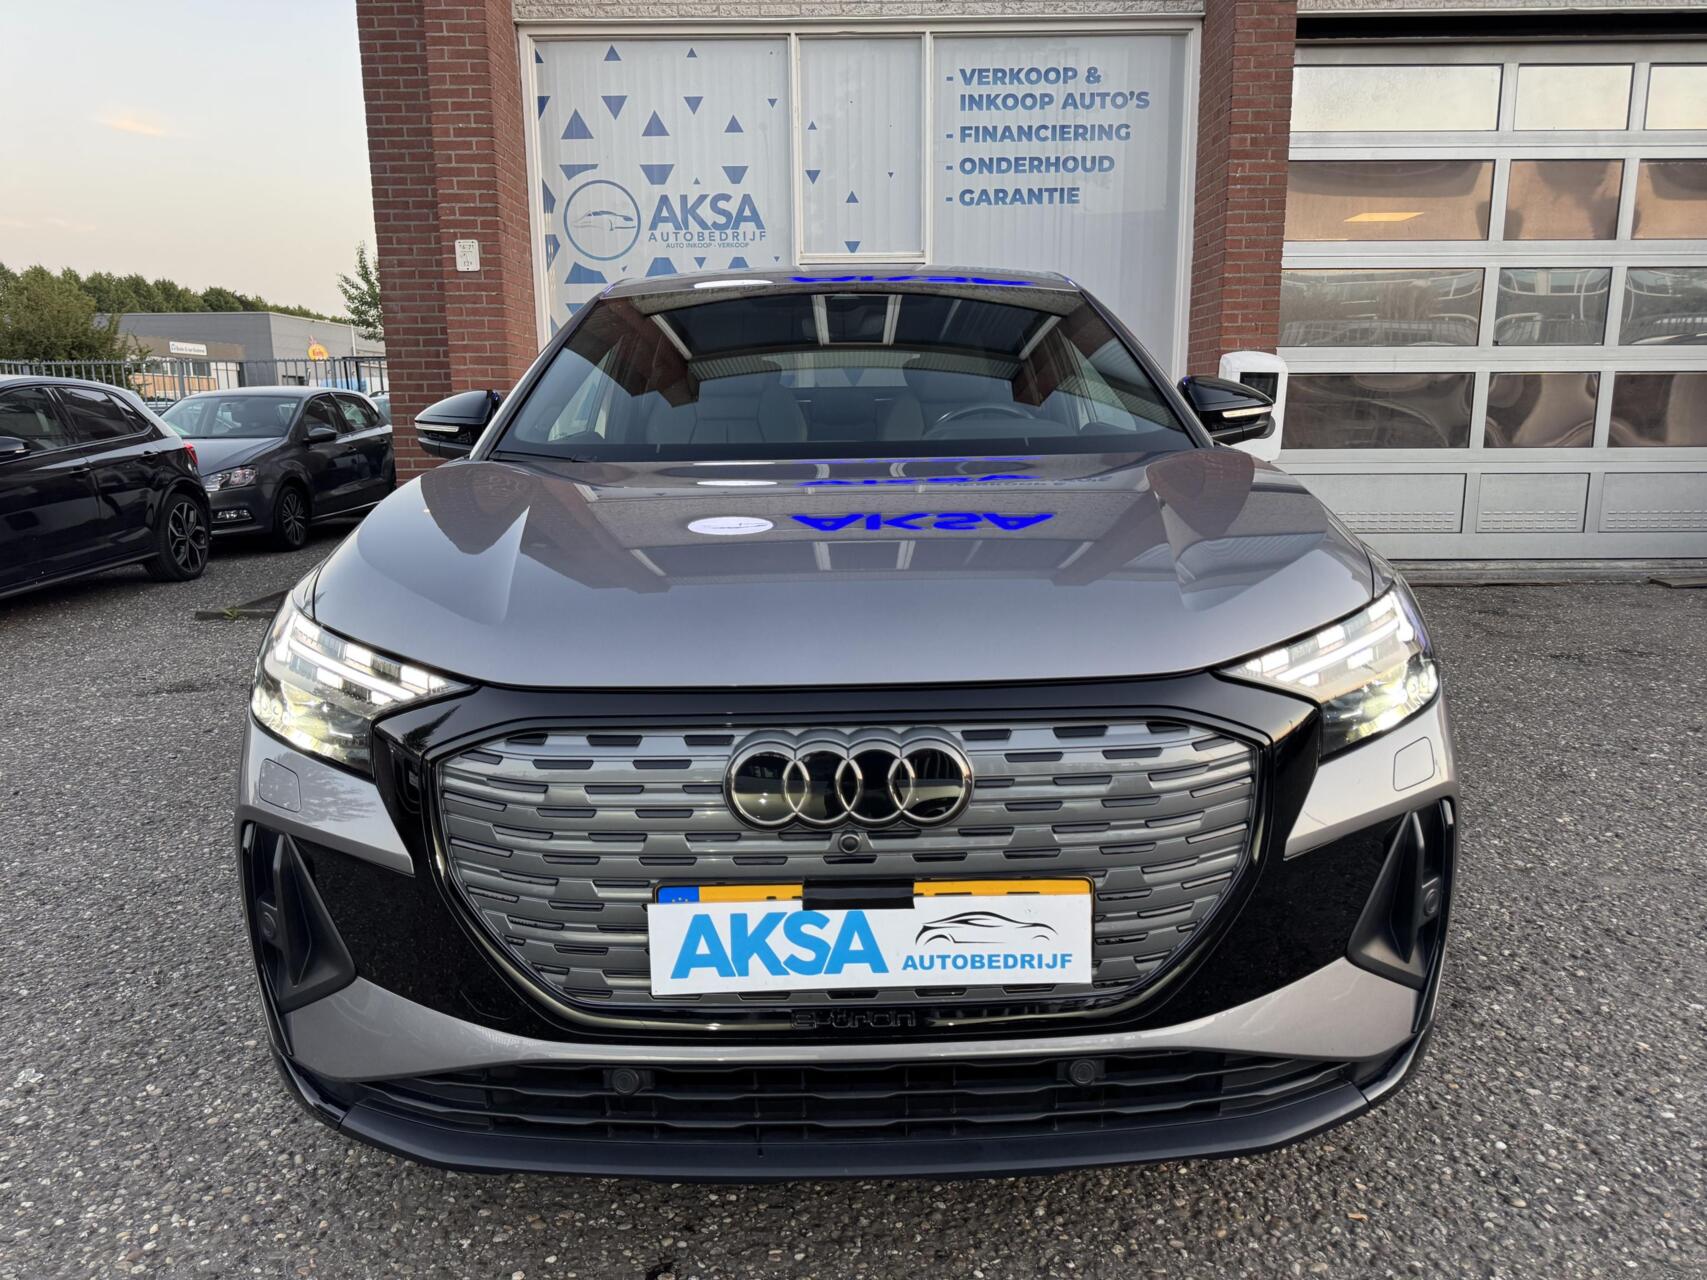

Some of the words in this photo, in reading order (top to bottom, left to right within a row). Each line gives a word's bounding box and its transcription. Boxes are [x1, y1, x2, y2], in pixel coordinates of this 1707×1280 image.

[959, 67, 1078, 86] VERKOOP
[1085, 66, 1102, 85] &
[959, 93, 1055, 112] INKOOP
[1061, 91, 1151, 111] AUTO'S
[959, 123, 1132, 143] FINANCIERING
[959, 155, 1116, 175] ONDERHOUD
[958, 187, 1081, 207] GARANTIE
[648, 193, 766, 231] AKSA
[648, 231, 767, 242] AUTOBEDRIJF
[670, 909, 890, 980] AKSA
[902, 952, 1074, 971] AUTOBEDRIJF
